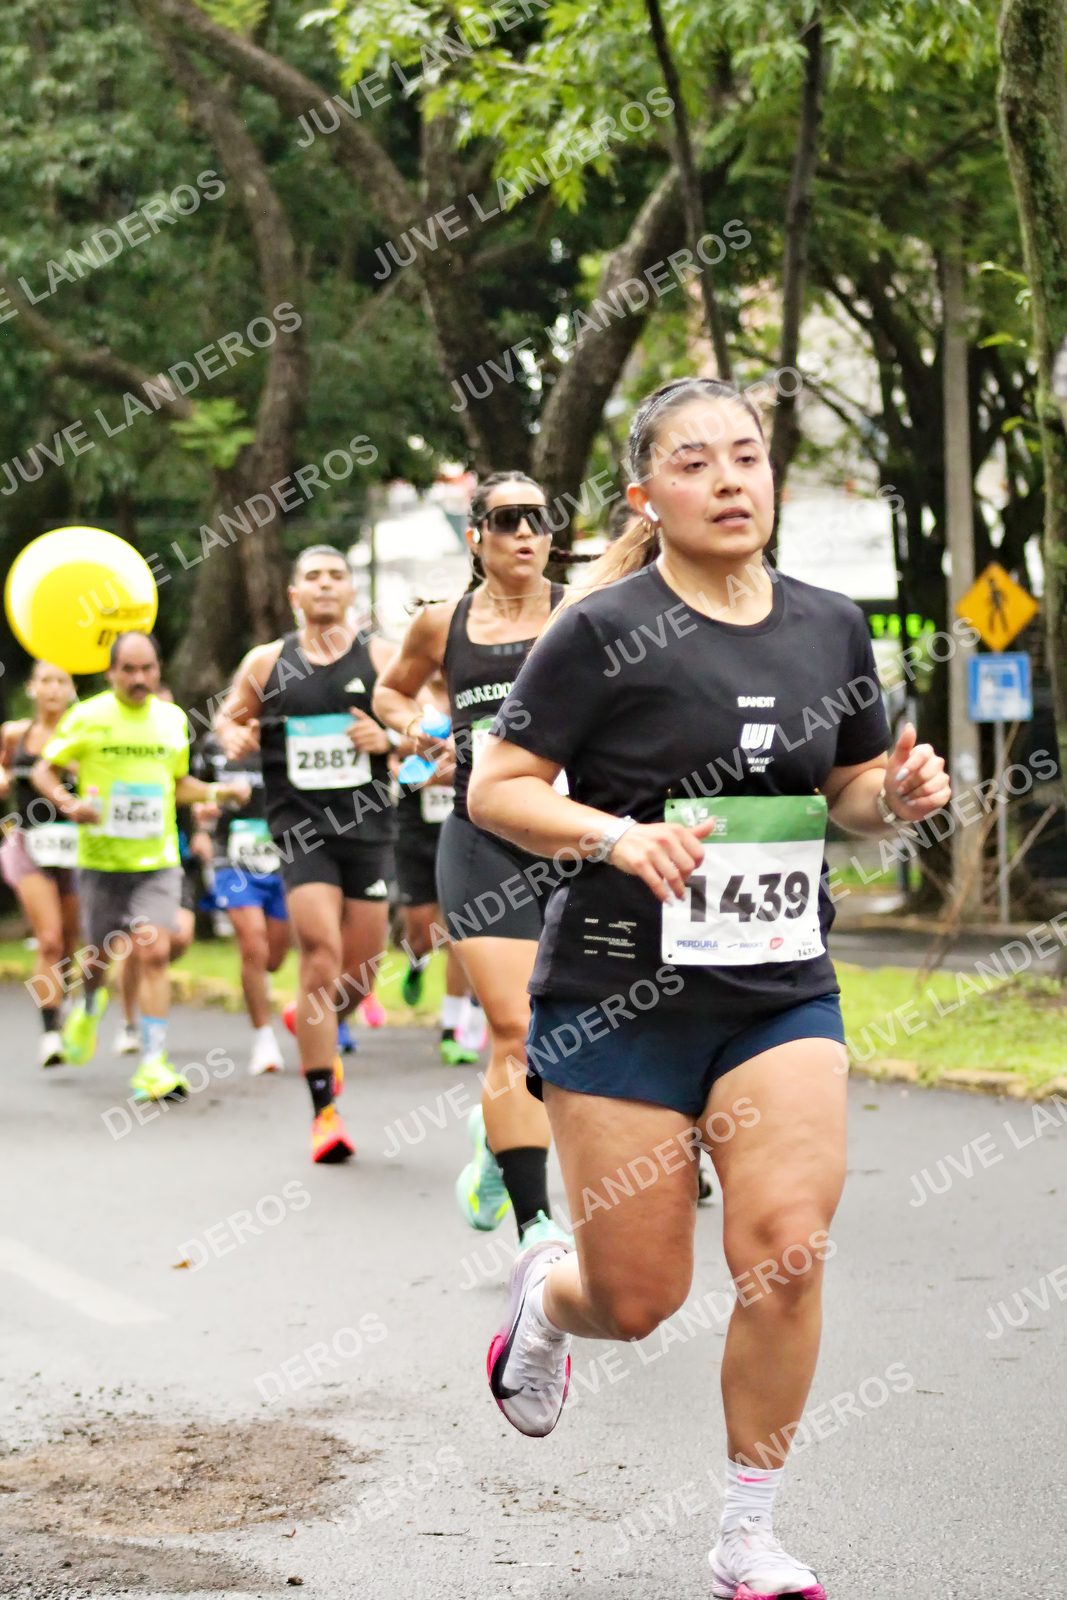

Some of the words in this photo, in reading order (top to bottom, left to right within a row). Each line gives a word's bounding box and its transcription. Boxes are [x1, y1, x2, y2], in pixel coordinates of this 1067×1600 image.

[455, 681, 516, 710] CORREDO
[737, 696, 775, 708] BANDIT
[298, 748, 361, 769] 2887
[750, 765, 766, 773] ONE
[685, 871, 810, 922] 1439
[676, 939, 718, 948] PERDURA
